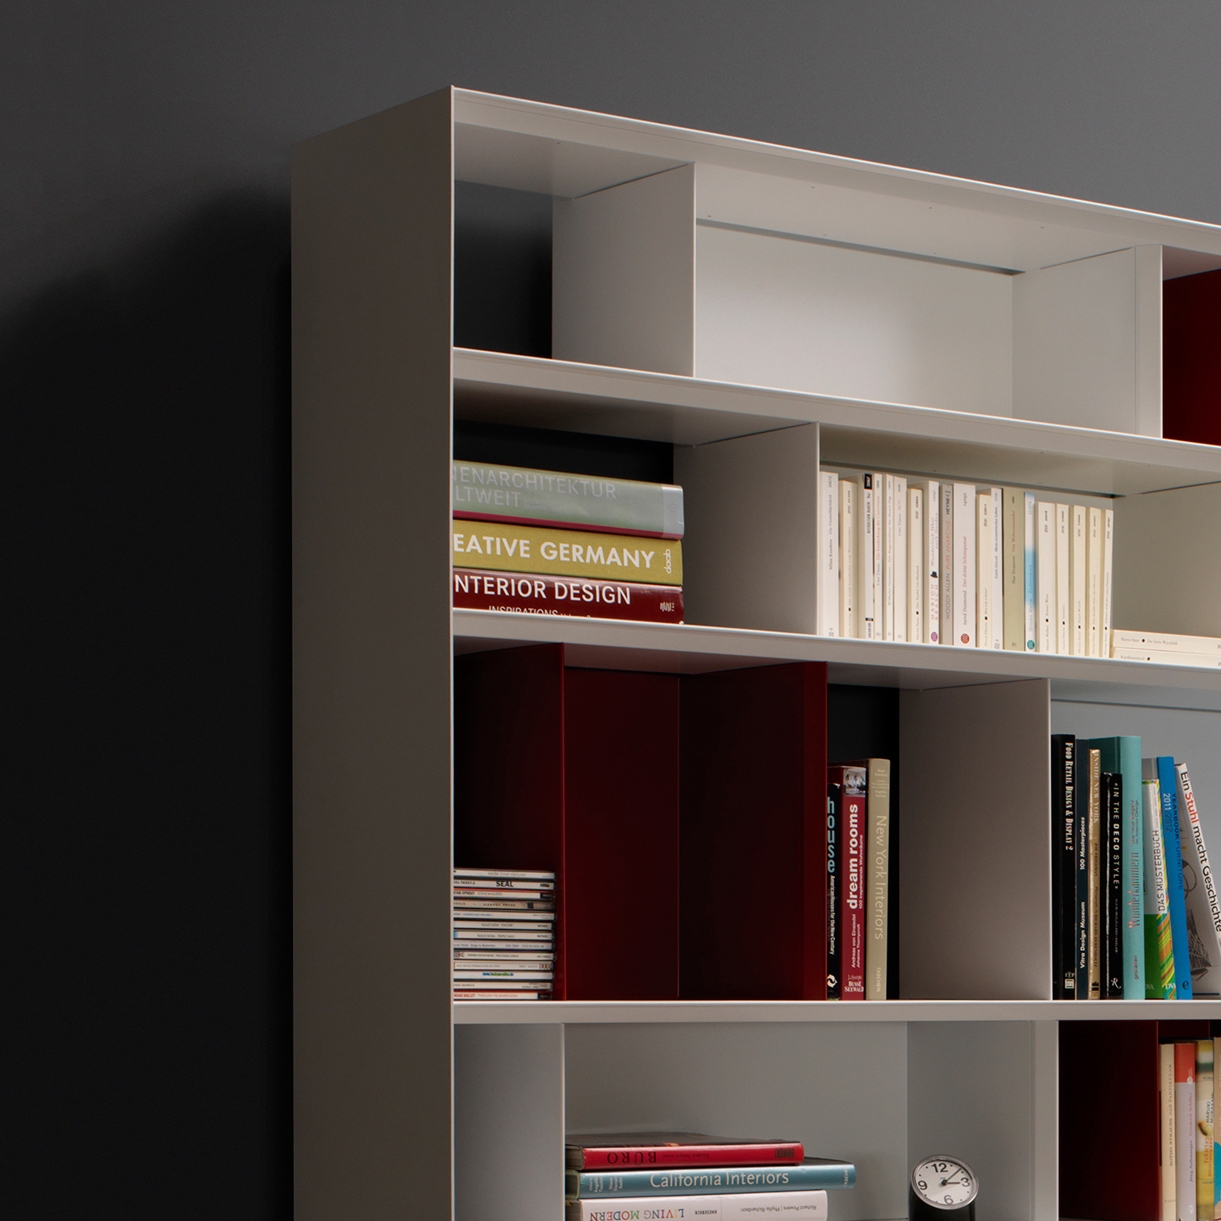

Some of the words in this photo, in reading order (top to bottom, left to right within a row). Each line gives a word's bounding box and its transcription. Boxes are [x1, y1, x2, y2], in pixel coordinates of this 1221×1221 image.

[540, 541, 655, 575] GERMANY
[454, 574, 546, 600] NTERIOR
[555, 581, 632, 605] DESIGN
[1064, 742, 1074, 760] FOOD
[1064, 760, 1074, 784] RETAIL
[1064, 786, 1074, 809] DESIGN
[1112, 802, 1120, 820] THE
[1171, 792, 1180, 840] YEARBOOK
[1179, 772, 1191, 791] Ein
[1185, 792, 1200, 824] Stuhl
[1193, 826, 1208, 864] macht
[848, 804, 859, 854] rooms
[876, 815, 887, 847] New
[1064, 818, 1074, 844] DISPLAY
[1112, 823, 1120, 851] DECO
[875, 848, 887, 878] York
[1152, 830, 1163, 892] MUSTERBUCH
[847, 857, 858, 910] dream
[874, 882, 887, 940] Interiors
[1156, 894, 1166, 912] DAS
[606, 1150, 658, 1165] BÜRO
[931, 1162, 949, 1173] 12
[650, 1172, 721, 1188] California
[726, 1170, 790, 1185] Interiors
[917, 1180, 928, 1191] 9
[960, 1177, 970, 1188] 3
[800, 1204, 817, 1212] Richard
[943, 1194, 954, 1206] 6
[590, 1210, 640, 1221] MODERN
[644, 1208, 684, 1220] LIVING
